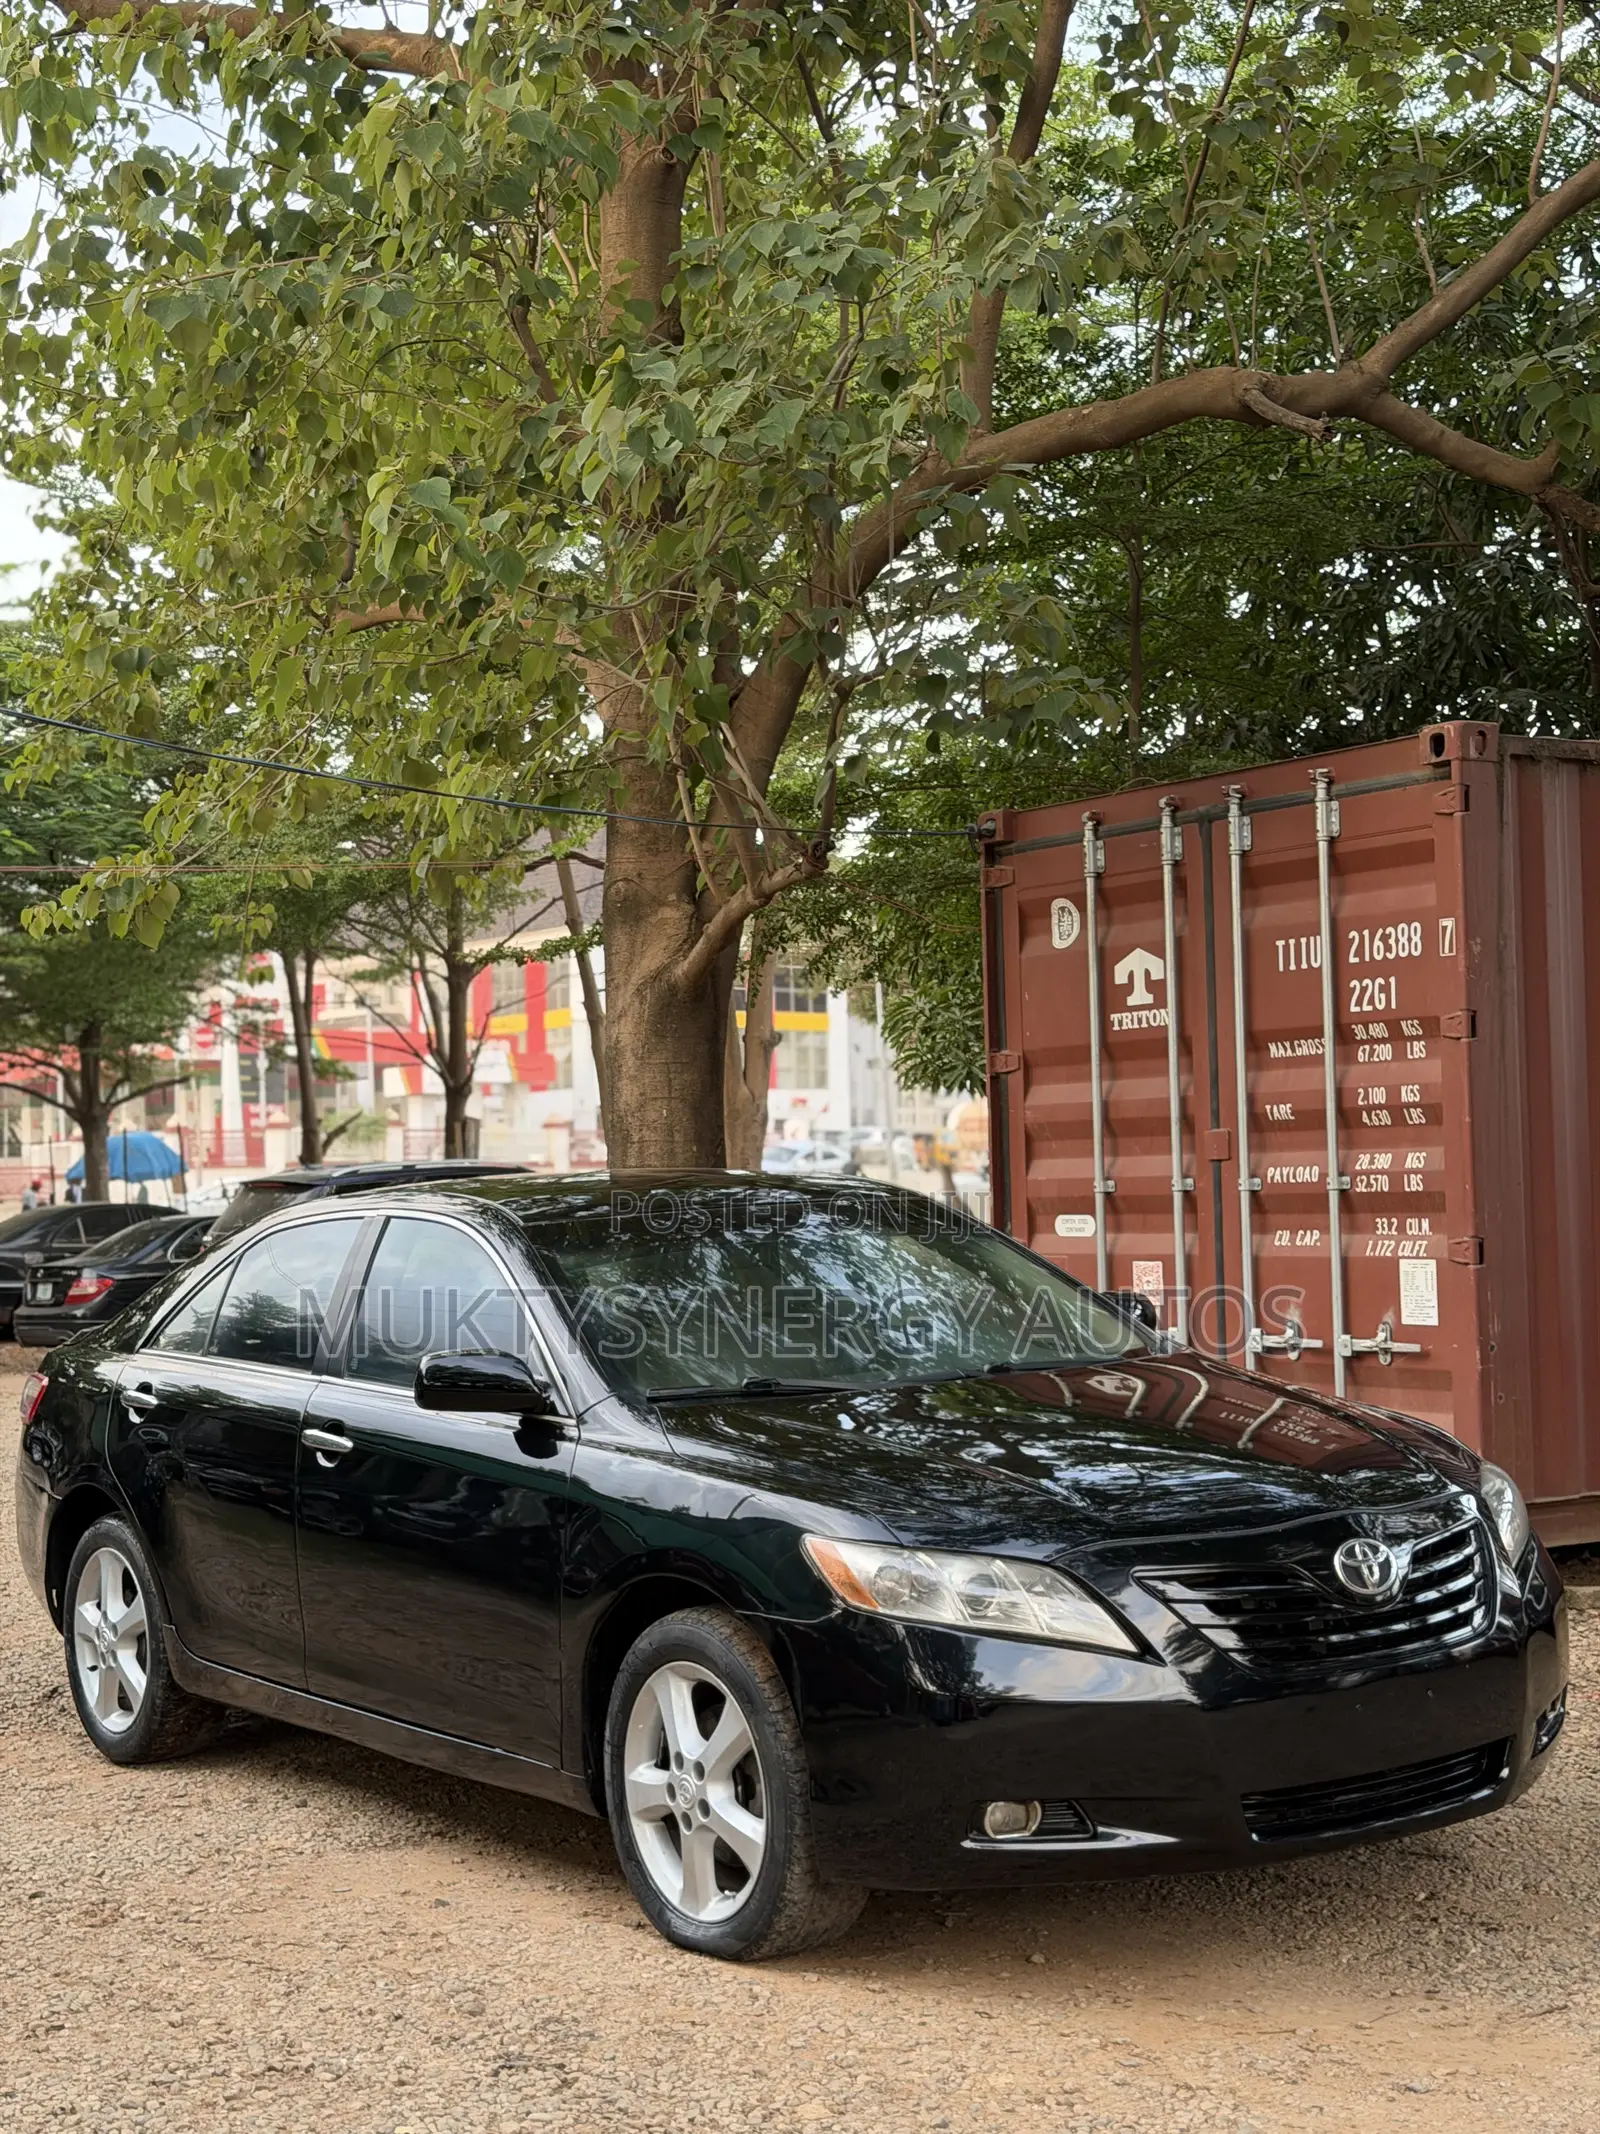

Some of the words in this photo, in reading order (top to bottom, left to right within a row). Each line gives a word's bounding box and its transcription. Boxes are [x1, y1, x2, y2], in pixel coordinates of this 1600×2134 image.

[1275, 935, 1321, 972] TIIU
[1348, 921, 1422, 963] 216388
[1349, 976, 1397, 1013] 22G1
[1110, 1008, 1170, 1031] TRITON
[1351, 1022, 1388, 1041] 30.480
[1400, 1019, 1423, 1037] KGS
[1357, 1043, 1392, 1062] 67.200
[1406, 1041, 1426, 1060] LBS
[1357, 1086, 1386, 1106] 2.100
[1400, 1084, 1420, 1103] KGS
[1265, 1103, 1296, 1121] TARE
[1361, 1109, 1392, 1127] 4.630
[1403, 1107, 1427, 1125] LBS
[1355, 1153, 1392, 1170] 28.380
[1404, 1152, 1427, 1169] KGS
[1266, 1165, 1320, 1184] PAYLOAD
[1403, 1173, 1424, 1192] LBS
[1375, 1217, 1398, 1236] 33.2
[1274, 1229, 1291, 1247] CU.
[1295, 1228, 1321, 1247] CAP.
[1365, 1239, 1396, 1257] 1.172
[1397, 1239, 1428, 1257] CU.FT.
